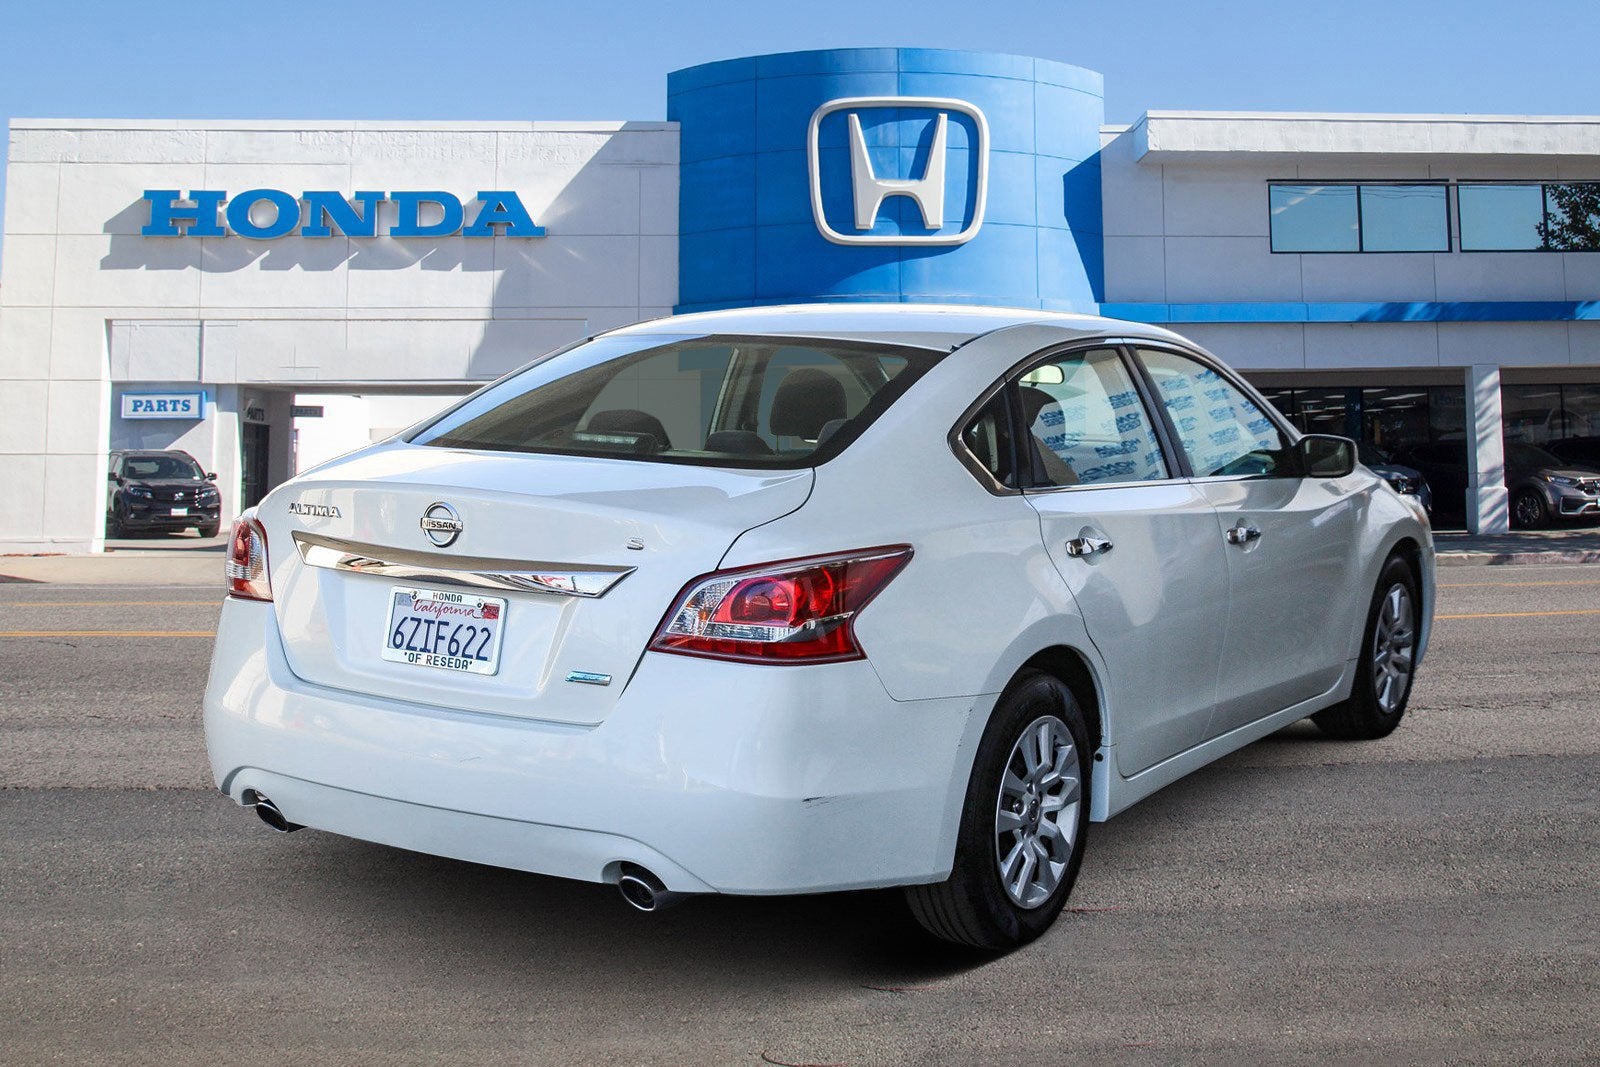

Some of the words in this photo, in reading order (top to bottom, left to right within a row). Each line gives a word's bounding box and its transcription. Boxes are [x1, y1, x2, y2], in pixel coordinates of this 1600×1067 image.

[142, 188, 547, 240] HONDA
[131, 399, 192, 413] PARTS
[288, 502, 342, 518] ALTIMA
[422, 519, 457, 530] NISSAN
[627, 537, 644, 550] S
[432, 591, 463, 603] HONDA
[413, 598, 482, 619] California
[392, 616, 489, 661] 6ZIF622
